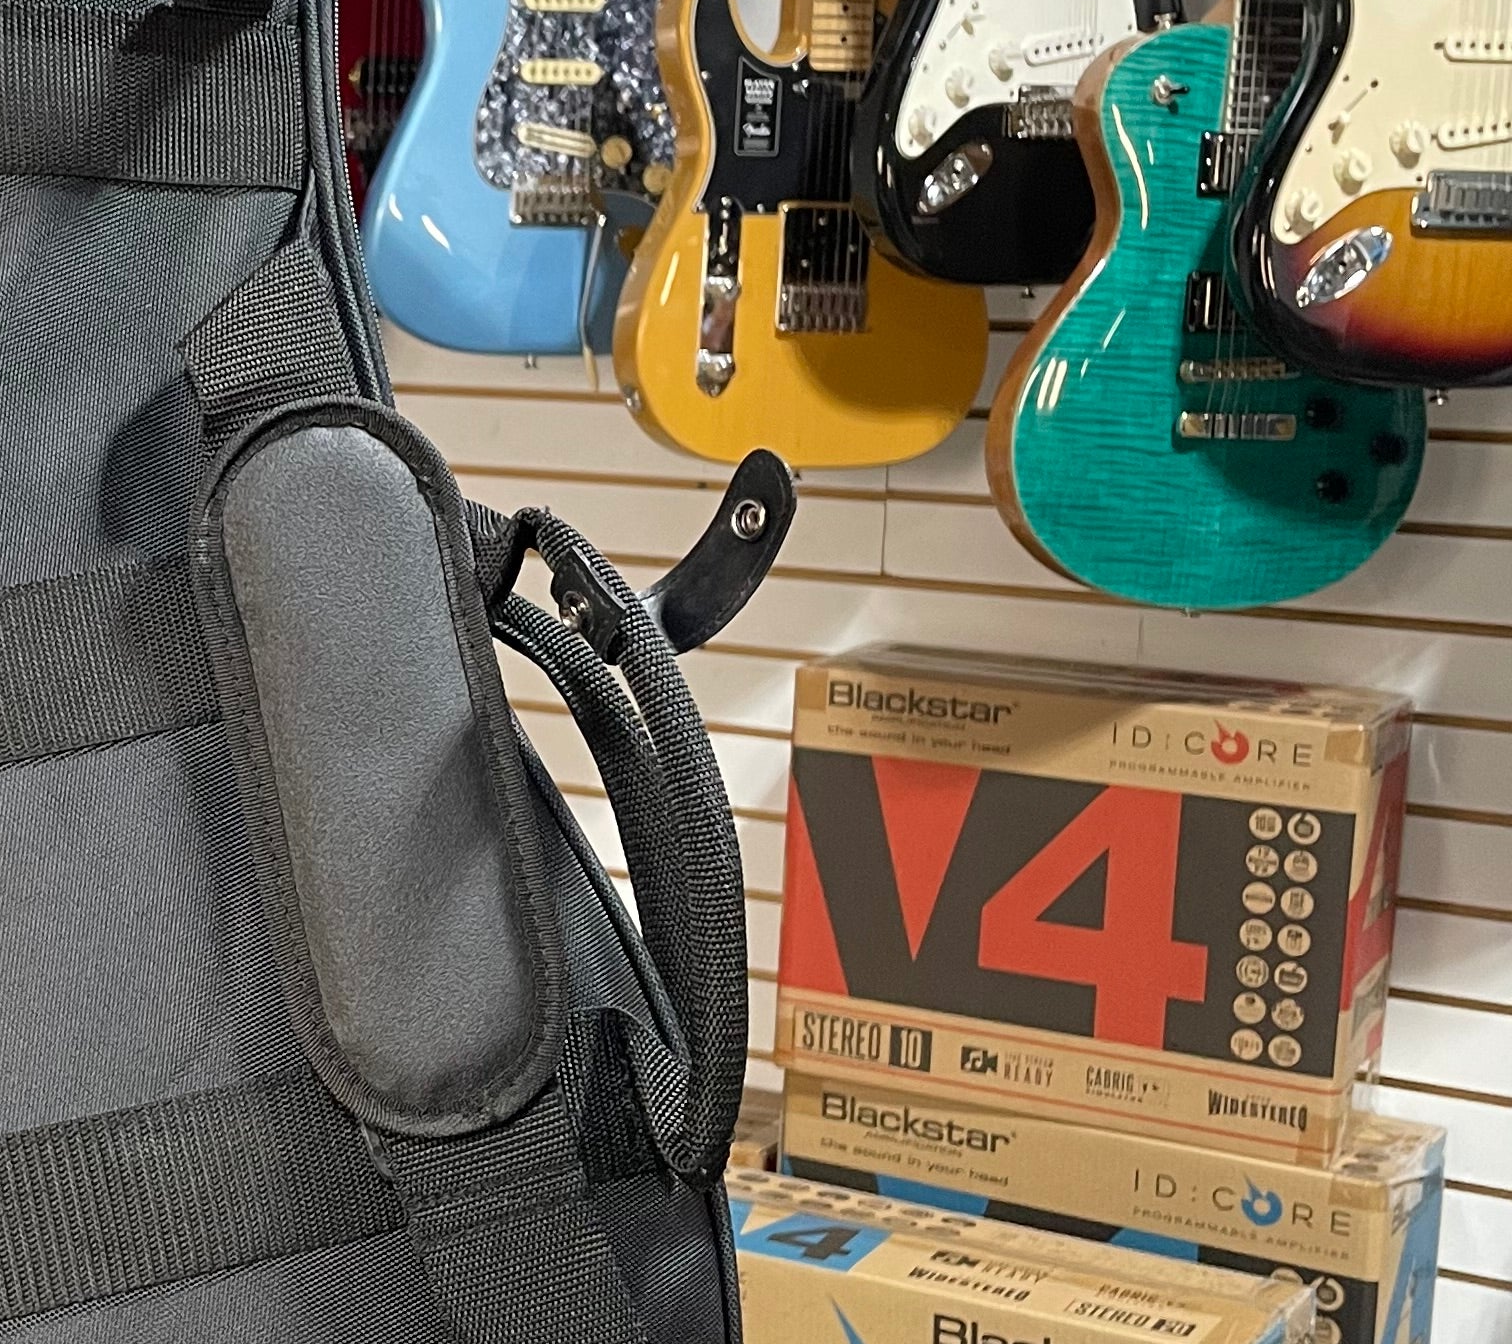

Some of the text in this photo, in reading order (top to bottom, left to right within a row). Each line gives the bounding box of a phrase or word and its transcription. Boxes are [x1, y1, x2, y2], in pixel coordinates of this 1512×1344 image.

[829, 679, 1012, 724] Blackstar
[803, 1011, 923, 1069] STEREO 10
[1003, 1063, 1054, 1089] READY
[822, 1091, 1011, 1154] Blackstar
[1208, 1088, 1308, 1133] WIDESTEREO
[1074, 1301, 1150, 1328] STEREO
